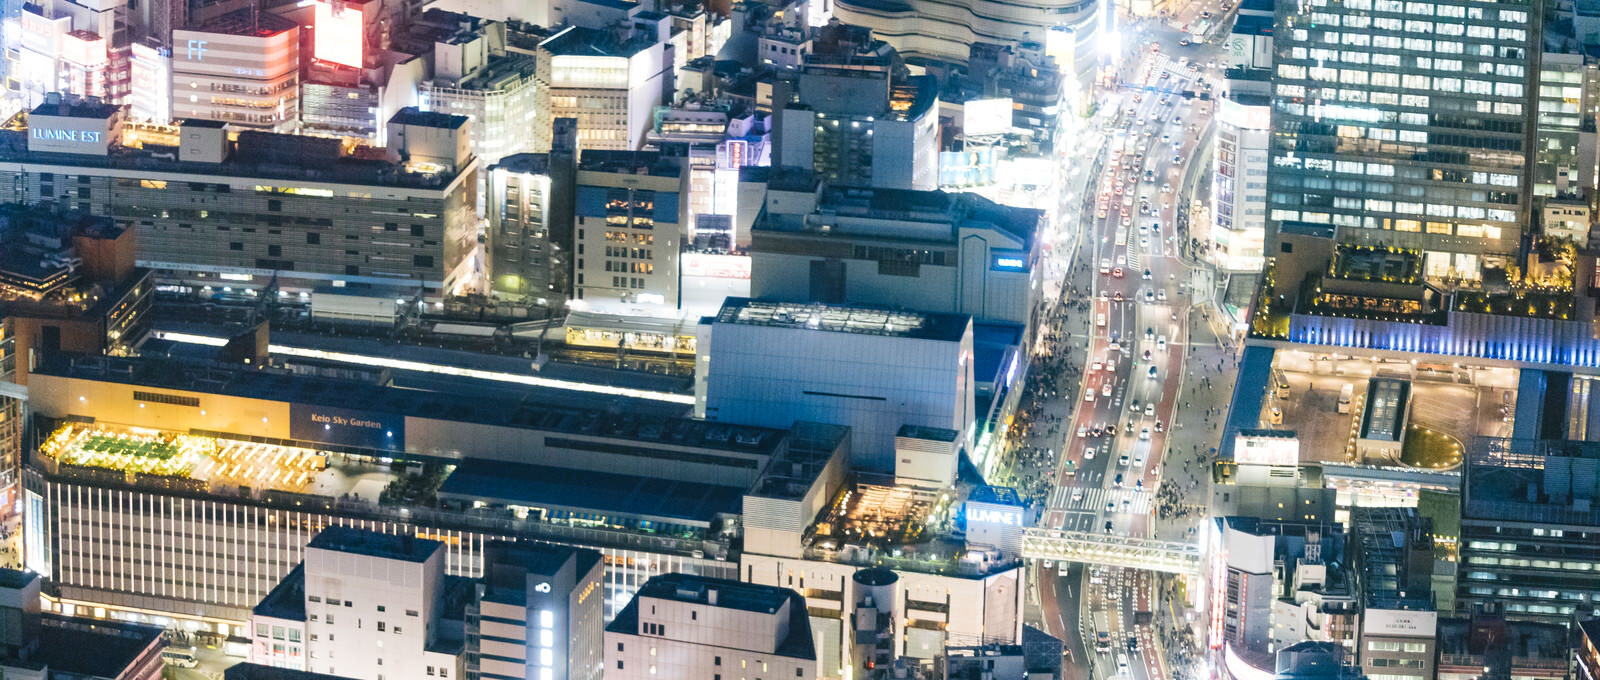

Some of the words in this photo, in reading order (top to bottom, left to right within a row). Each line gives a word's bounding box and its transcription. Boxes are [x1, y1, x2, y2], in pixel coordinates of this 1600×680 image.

[33, 128, 77, 141] LUMINE
[81, 130, 101, 143] EST
[332, 416, 348, 426] Sky
[349, 417, 382, 429] Garden
[967, 508, 1014, 525] LUMINE
